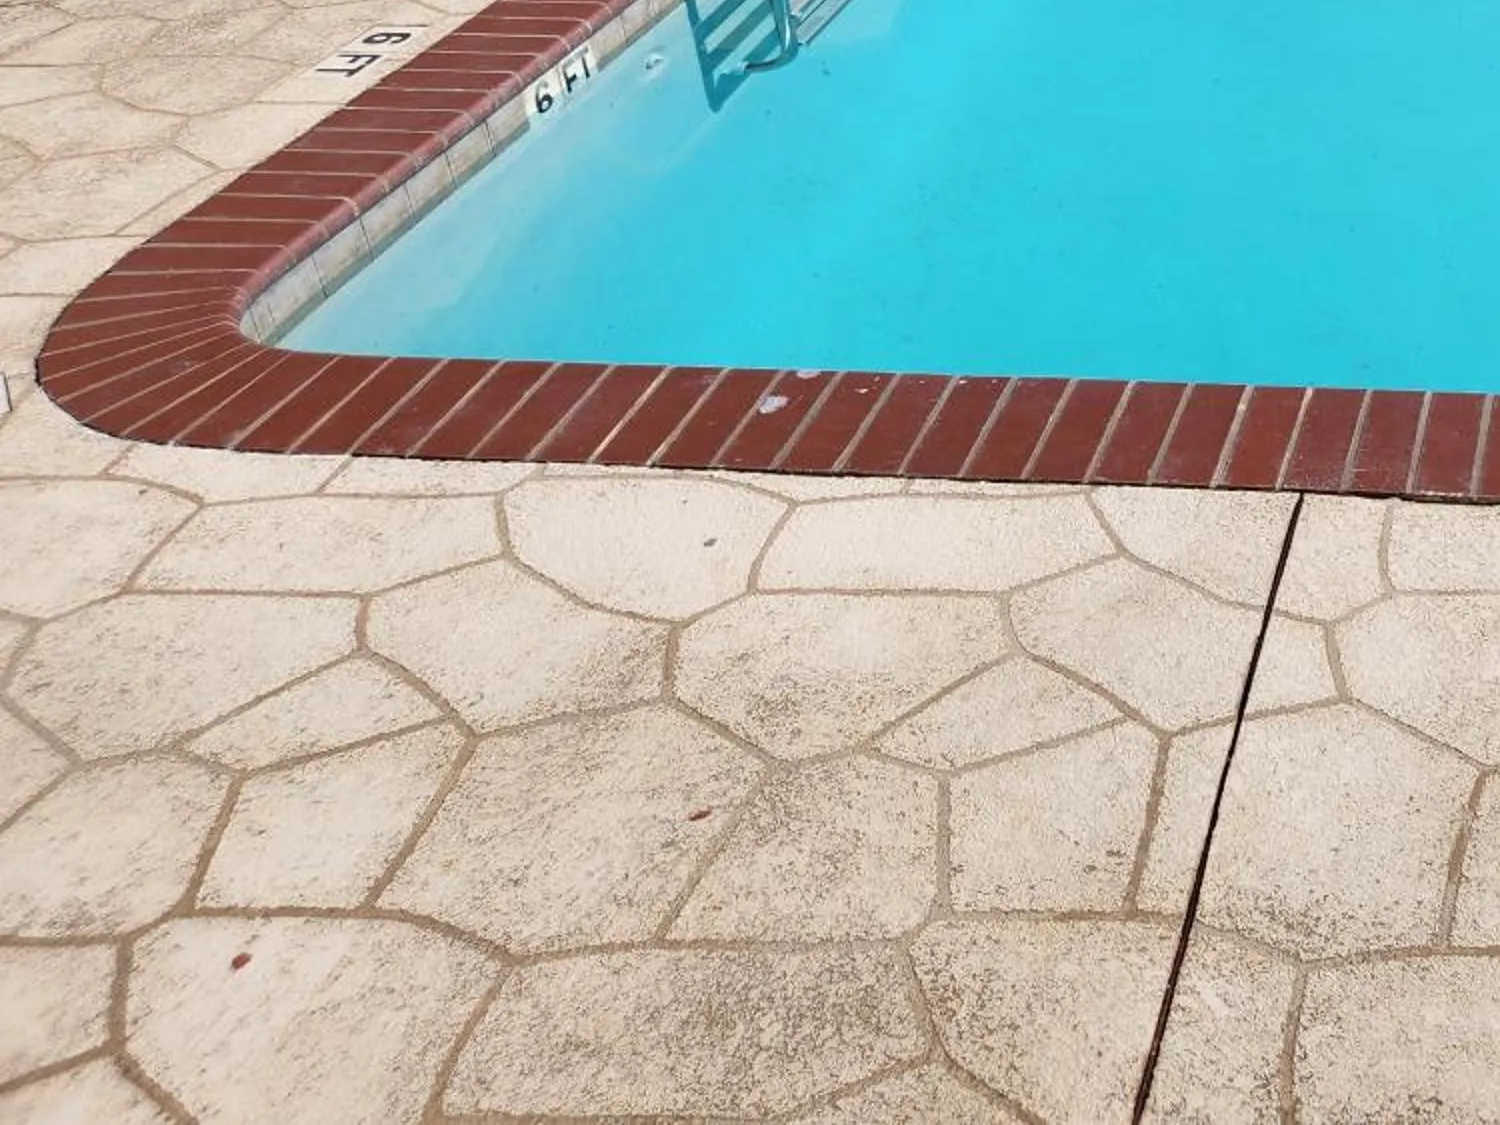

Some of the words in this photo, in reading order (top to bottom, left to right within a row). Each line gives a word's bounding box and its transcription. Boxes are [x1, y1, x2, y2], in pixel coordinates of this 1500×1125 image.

[362, 31, 412, 44] 6
[315, 53, 383, 78] FT
[535, 79, 553, 114] 6
[562, 44, 590, 93] FT
